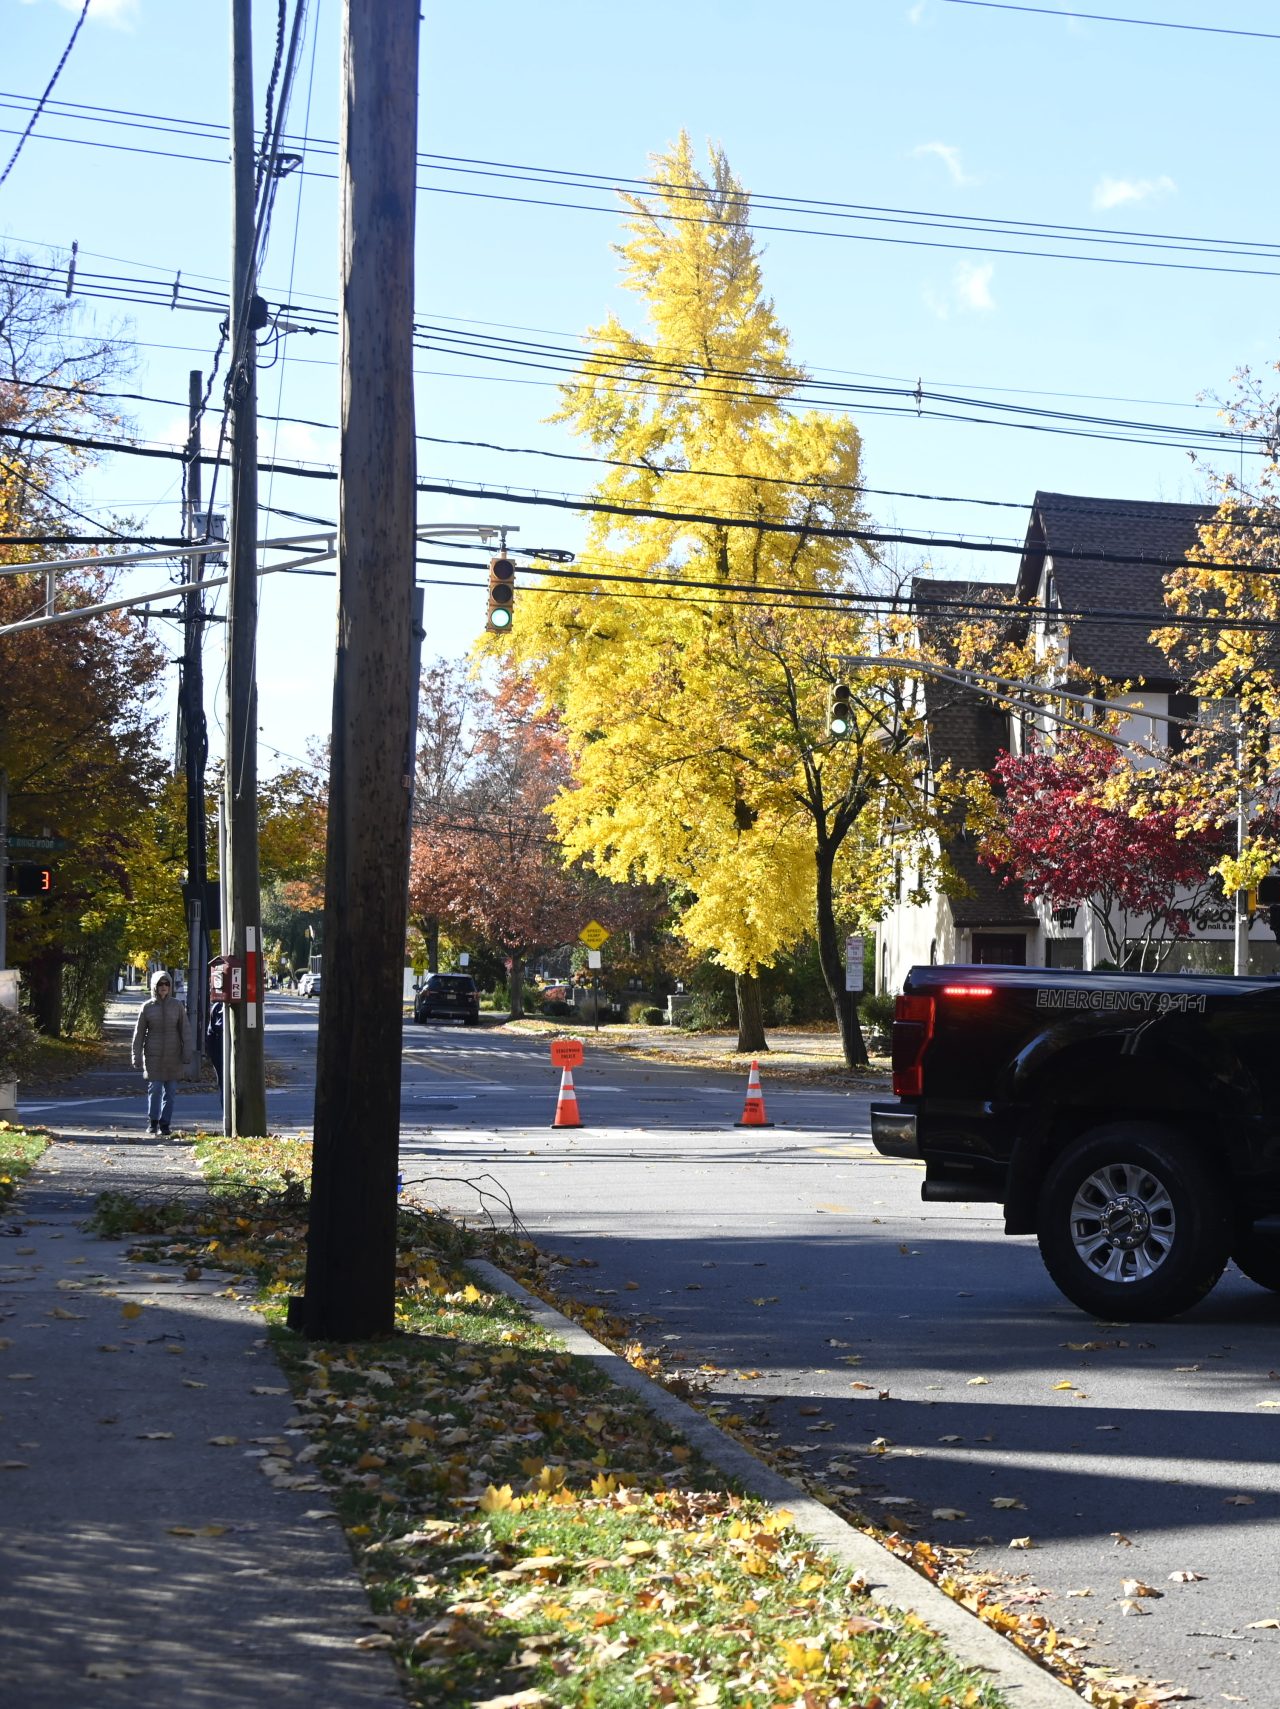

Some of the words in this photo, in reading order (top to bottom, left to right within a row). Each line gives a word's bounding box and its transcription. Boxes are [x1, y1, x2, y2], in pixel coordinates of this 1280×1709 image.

[41, 871, 49, 890] 3
[1208, 921, 1221, 930] nail
[232, 969, 240, 998] FIRE
[1036, 989, 1156, 1011] EMERGENCY
[1159, 993, 1207, 1013] 9-1-1
